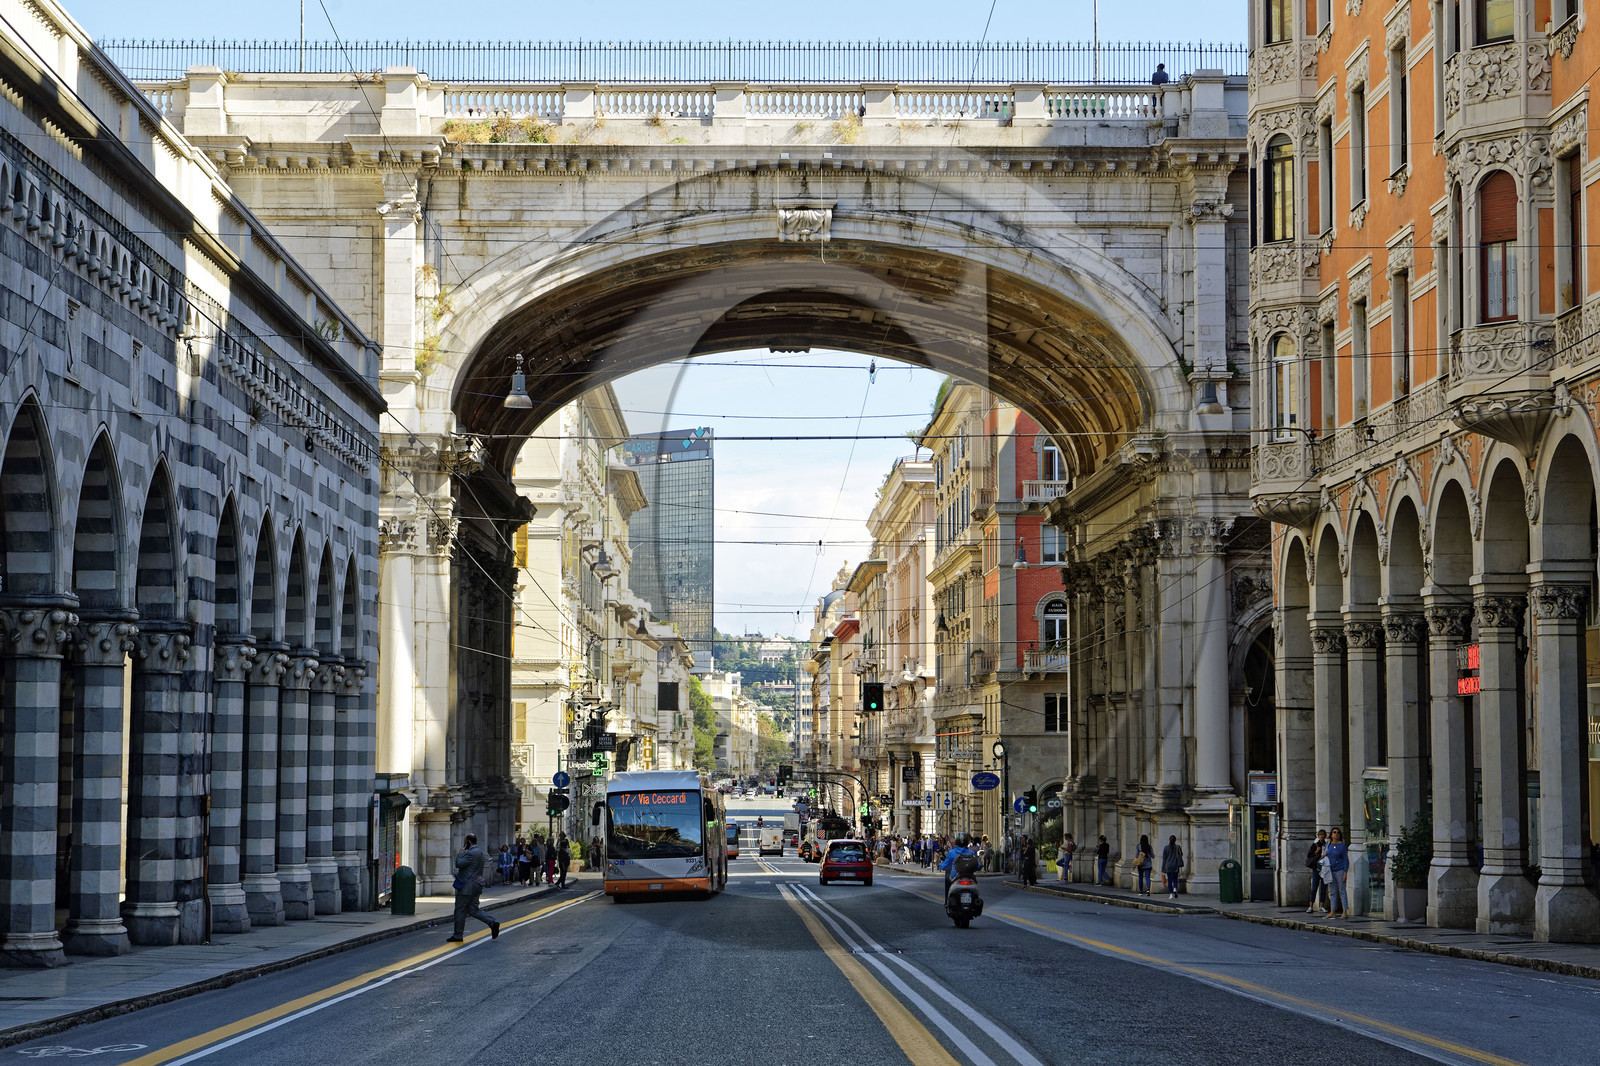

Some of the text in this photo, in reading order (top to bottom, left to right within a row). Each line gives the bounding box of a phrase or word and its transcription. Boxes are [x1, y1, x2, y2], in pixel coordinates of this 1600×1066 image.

[624, 441, 656, 453] CARIGE
[638, 793, 650, 805] Via
[652, 792, 687, 804] Ceccardi
